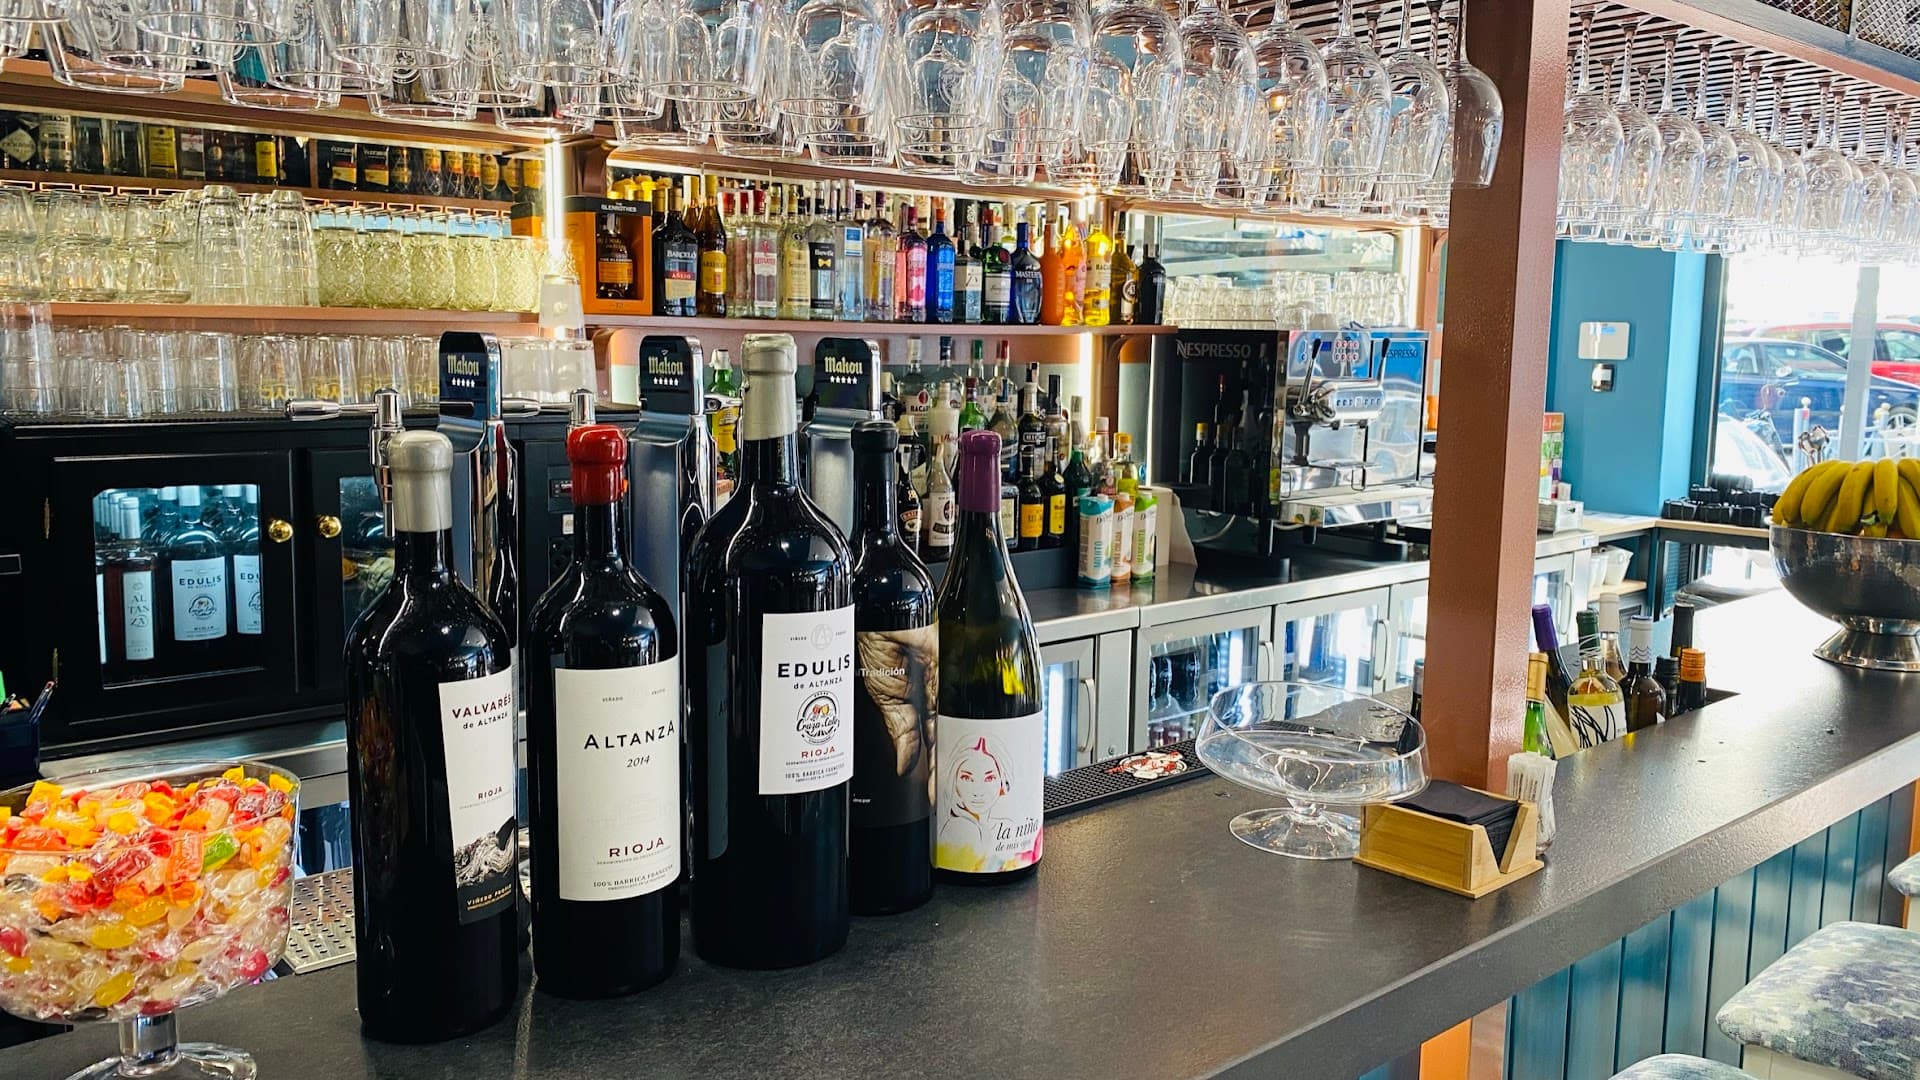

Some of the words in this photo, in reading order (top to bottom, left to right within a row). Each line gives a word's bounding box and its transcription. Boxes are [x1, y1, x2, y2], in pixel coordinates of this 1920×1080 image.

[1175, 339, 1251, 359] NESPRESSO
[1386, 349, 1418, 359] ESPRESSO
[447, 354, 480, 377] Mahou
[648, 356, 684, 376] Mahou
[824, 356, 863, 375] Mahou
[179, 575, 222, 586] EDULIS
[778, 654, 850, 678] EDULIS
[809, 676, 842, 688] ALTANZA
[451, 693, 511, 719] VALVARÉS
[583, 719, 675, 750] ALTANZA
[627, 754, 650, 768] 2014
[801, 745, 835, 758] RIOJA
[478, 785, 503, 801] RIOJA
[996, 822, 1011, 841] la
[609, 837, 665, 858] RIOJA
